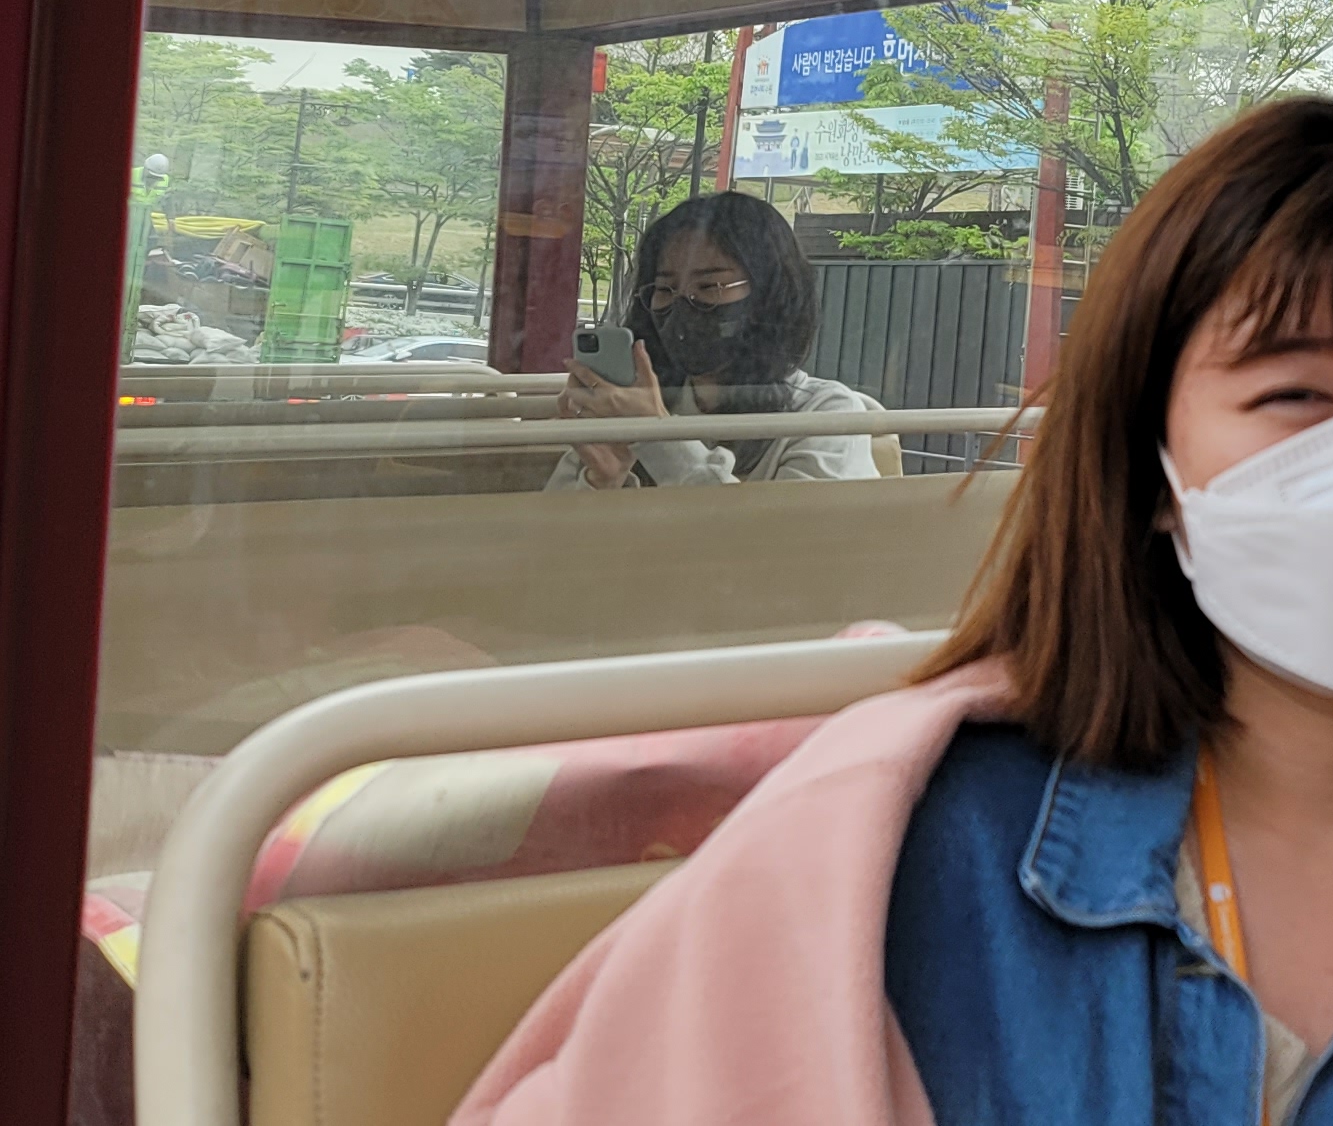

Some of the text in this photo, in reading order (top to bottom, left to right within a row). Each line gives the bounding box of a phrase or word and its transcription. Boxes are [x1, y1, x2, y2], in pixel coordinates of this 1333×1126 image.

[791, 53, 822, 77] 사람이
[823, 45, 876, 73] 반갑습니다
[814, 118, 864, 144] 수원화성
